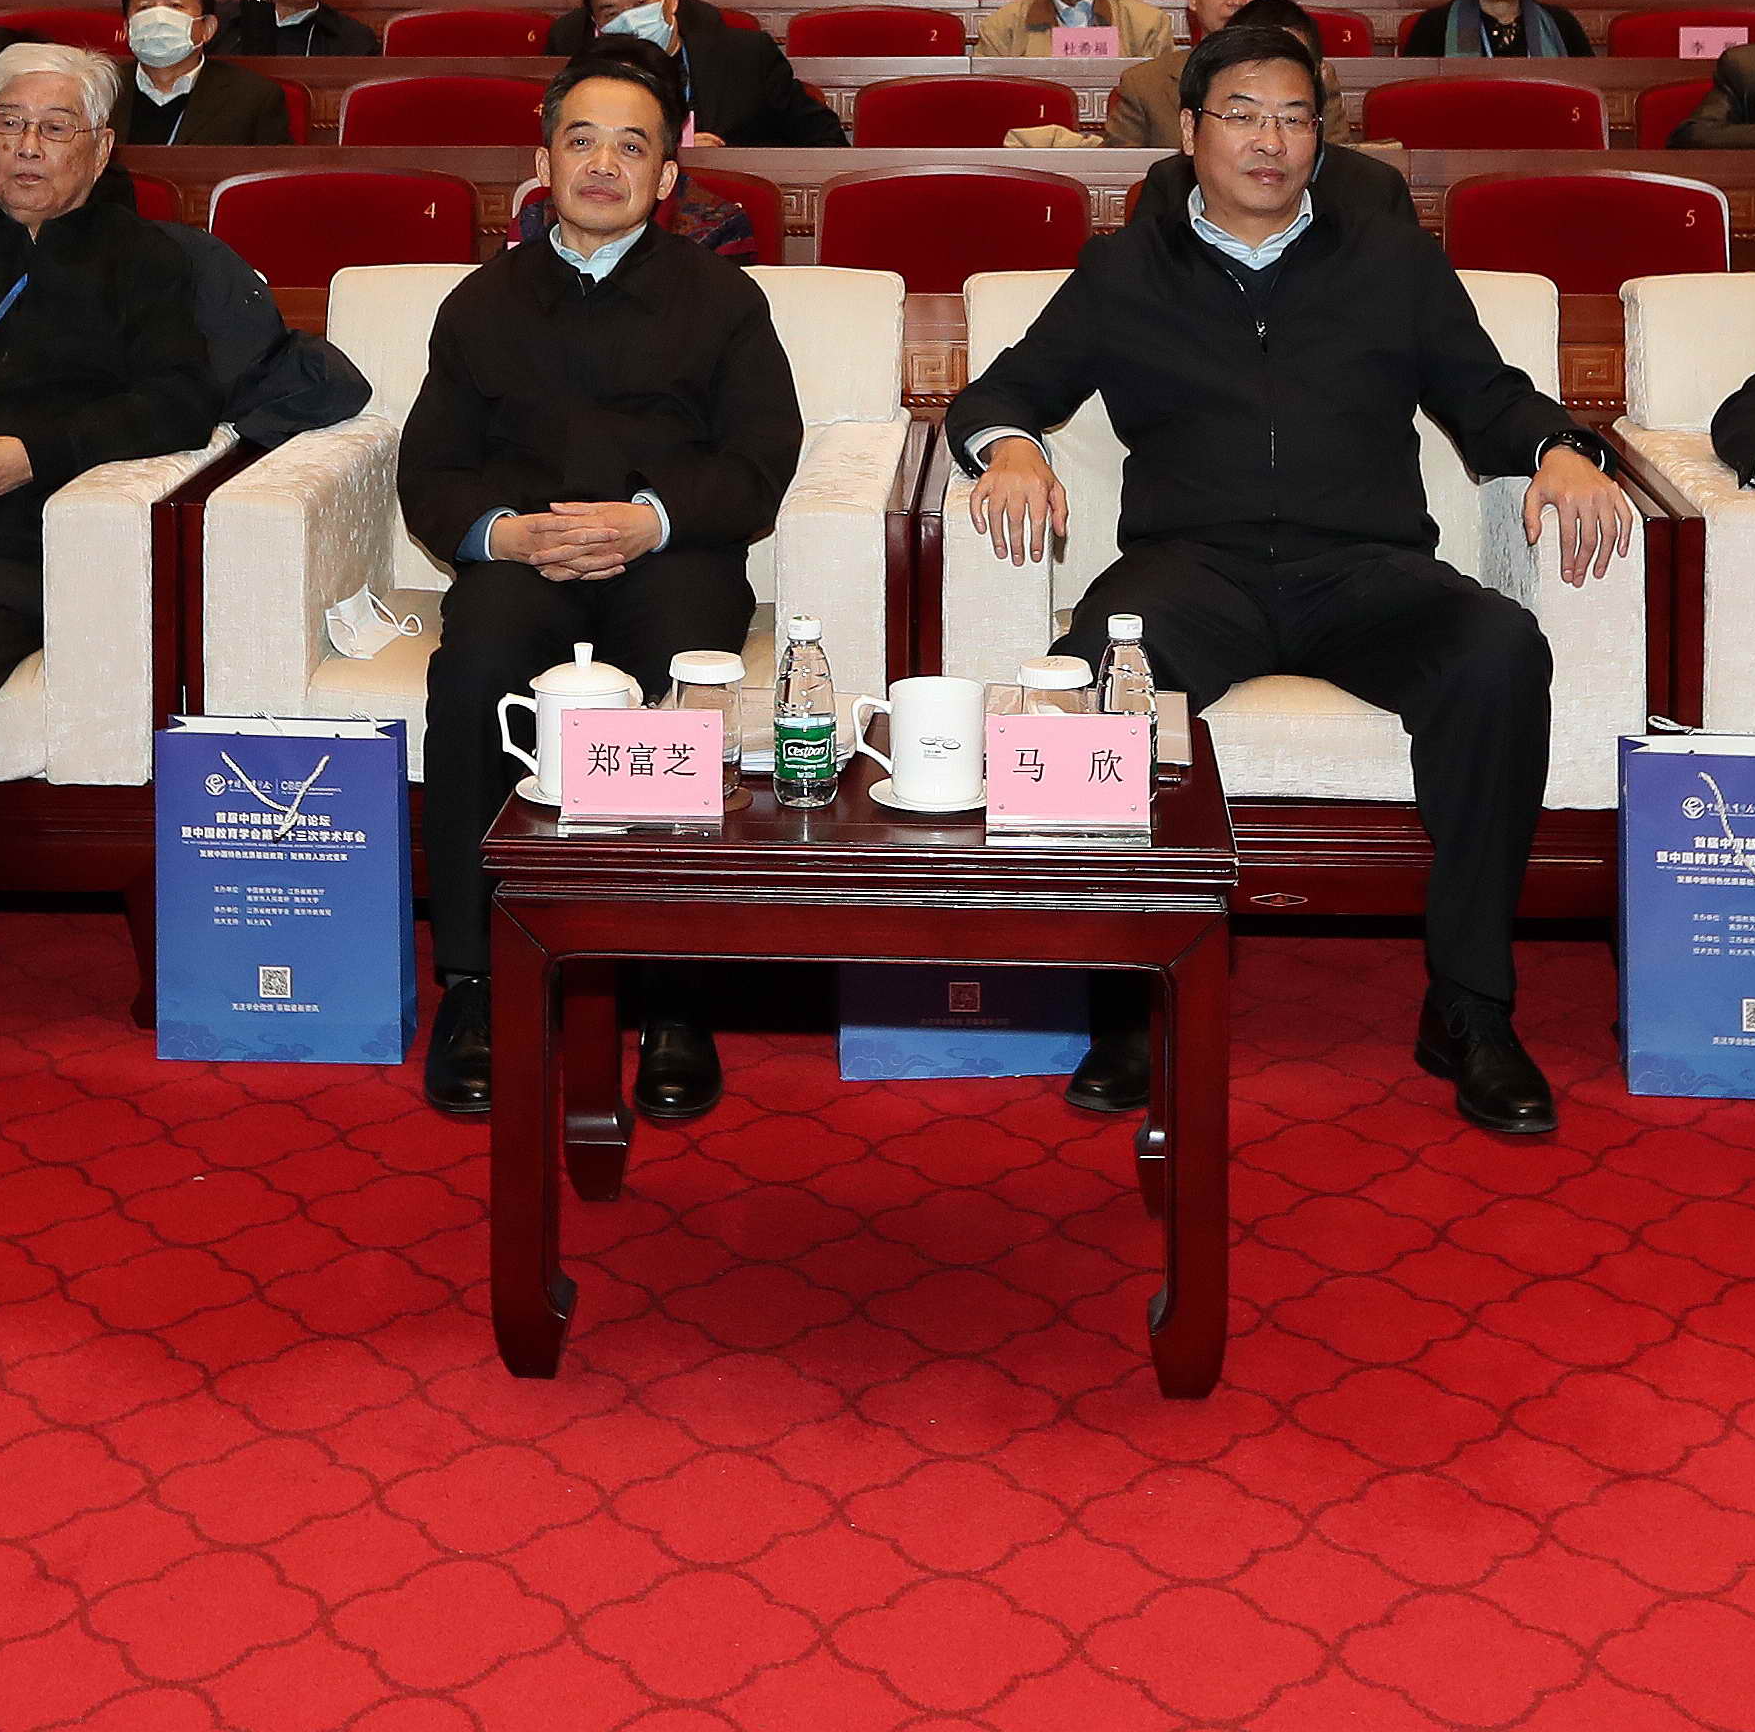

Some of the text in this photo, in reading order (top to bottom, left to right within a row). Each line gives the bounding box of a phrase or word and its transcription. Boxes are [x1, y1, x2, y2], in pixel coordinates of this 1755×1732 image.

[527, 29, 537, 42] 6
[929, 28, 938, 42] 2
[1341, 29, 1351, 43] 3
[533, 103, 544, 118] 4
[1038, 104, 1045, 119] 1
[1570, 106, 1580, 123] 5
[423, 202, 436, 220] 4
[1045, 205, 1052, 223] 1
[1685, 209, 1696, 228] 5
[587, 742, 697, 777] 郑富芝
[215, 812, 332, 827] 首届中国基础育论坛
